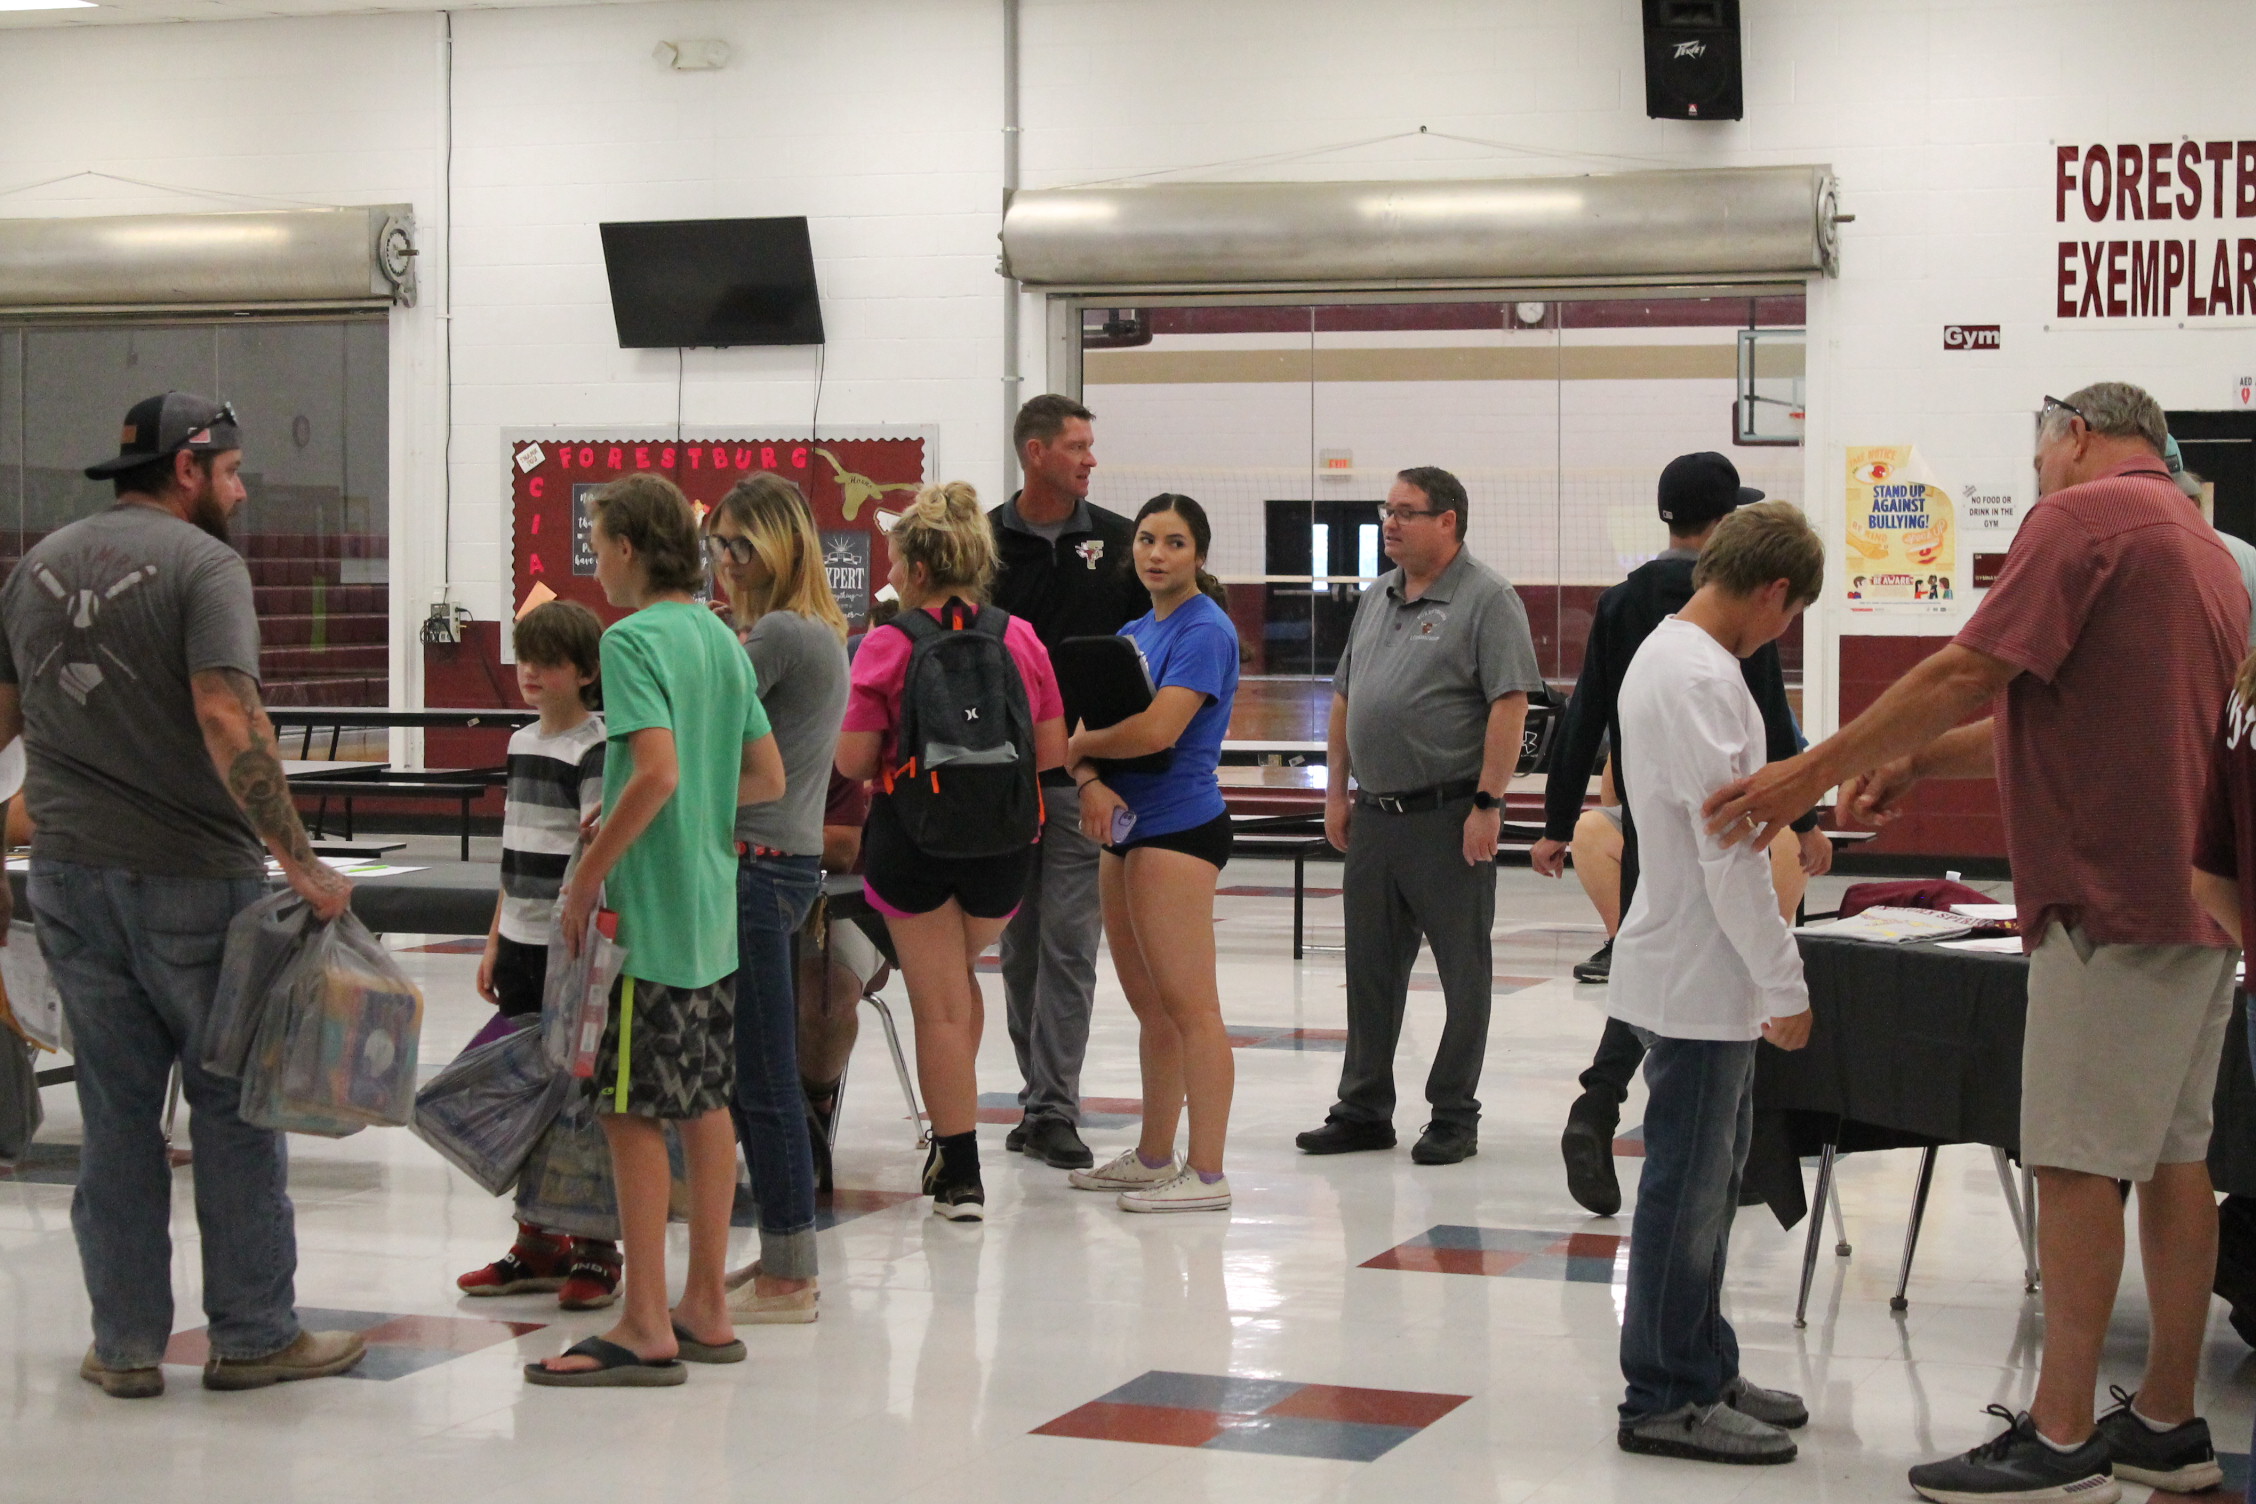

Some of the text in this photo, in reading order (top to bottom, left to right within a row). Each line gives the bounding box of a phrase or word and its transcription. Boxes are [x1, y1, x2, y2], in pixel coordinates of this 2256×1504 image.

[2056, 140, 2256, 223] FORESTB
[2057, 238, 2256, 318] EXEMPLAR
[1944, 326, 2000, 349] Gym
[2239, 376, 2253, 386] AED
[559, 447, 808, 470] FORESTBURG
[1873, 485, 1926, 498] STAND UP
[1872, 498, 1926, 513] AGAINST
[1971, 496, 2012, 504] NO FOOD OR
[1969, 508, 2014, 516] DRINK IN THE
[1868, 514, 1930, 529] BULLYING!
[1984, 520, 1999, 528] GYM
[825, 567, 865, 590] XPERT
